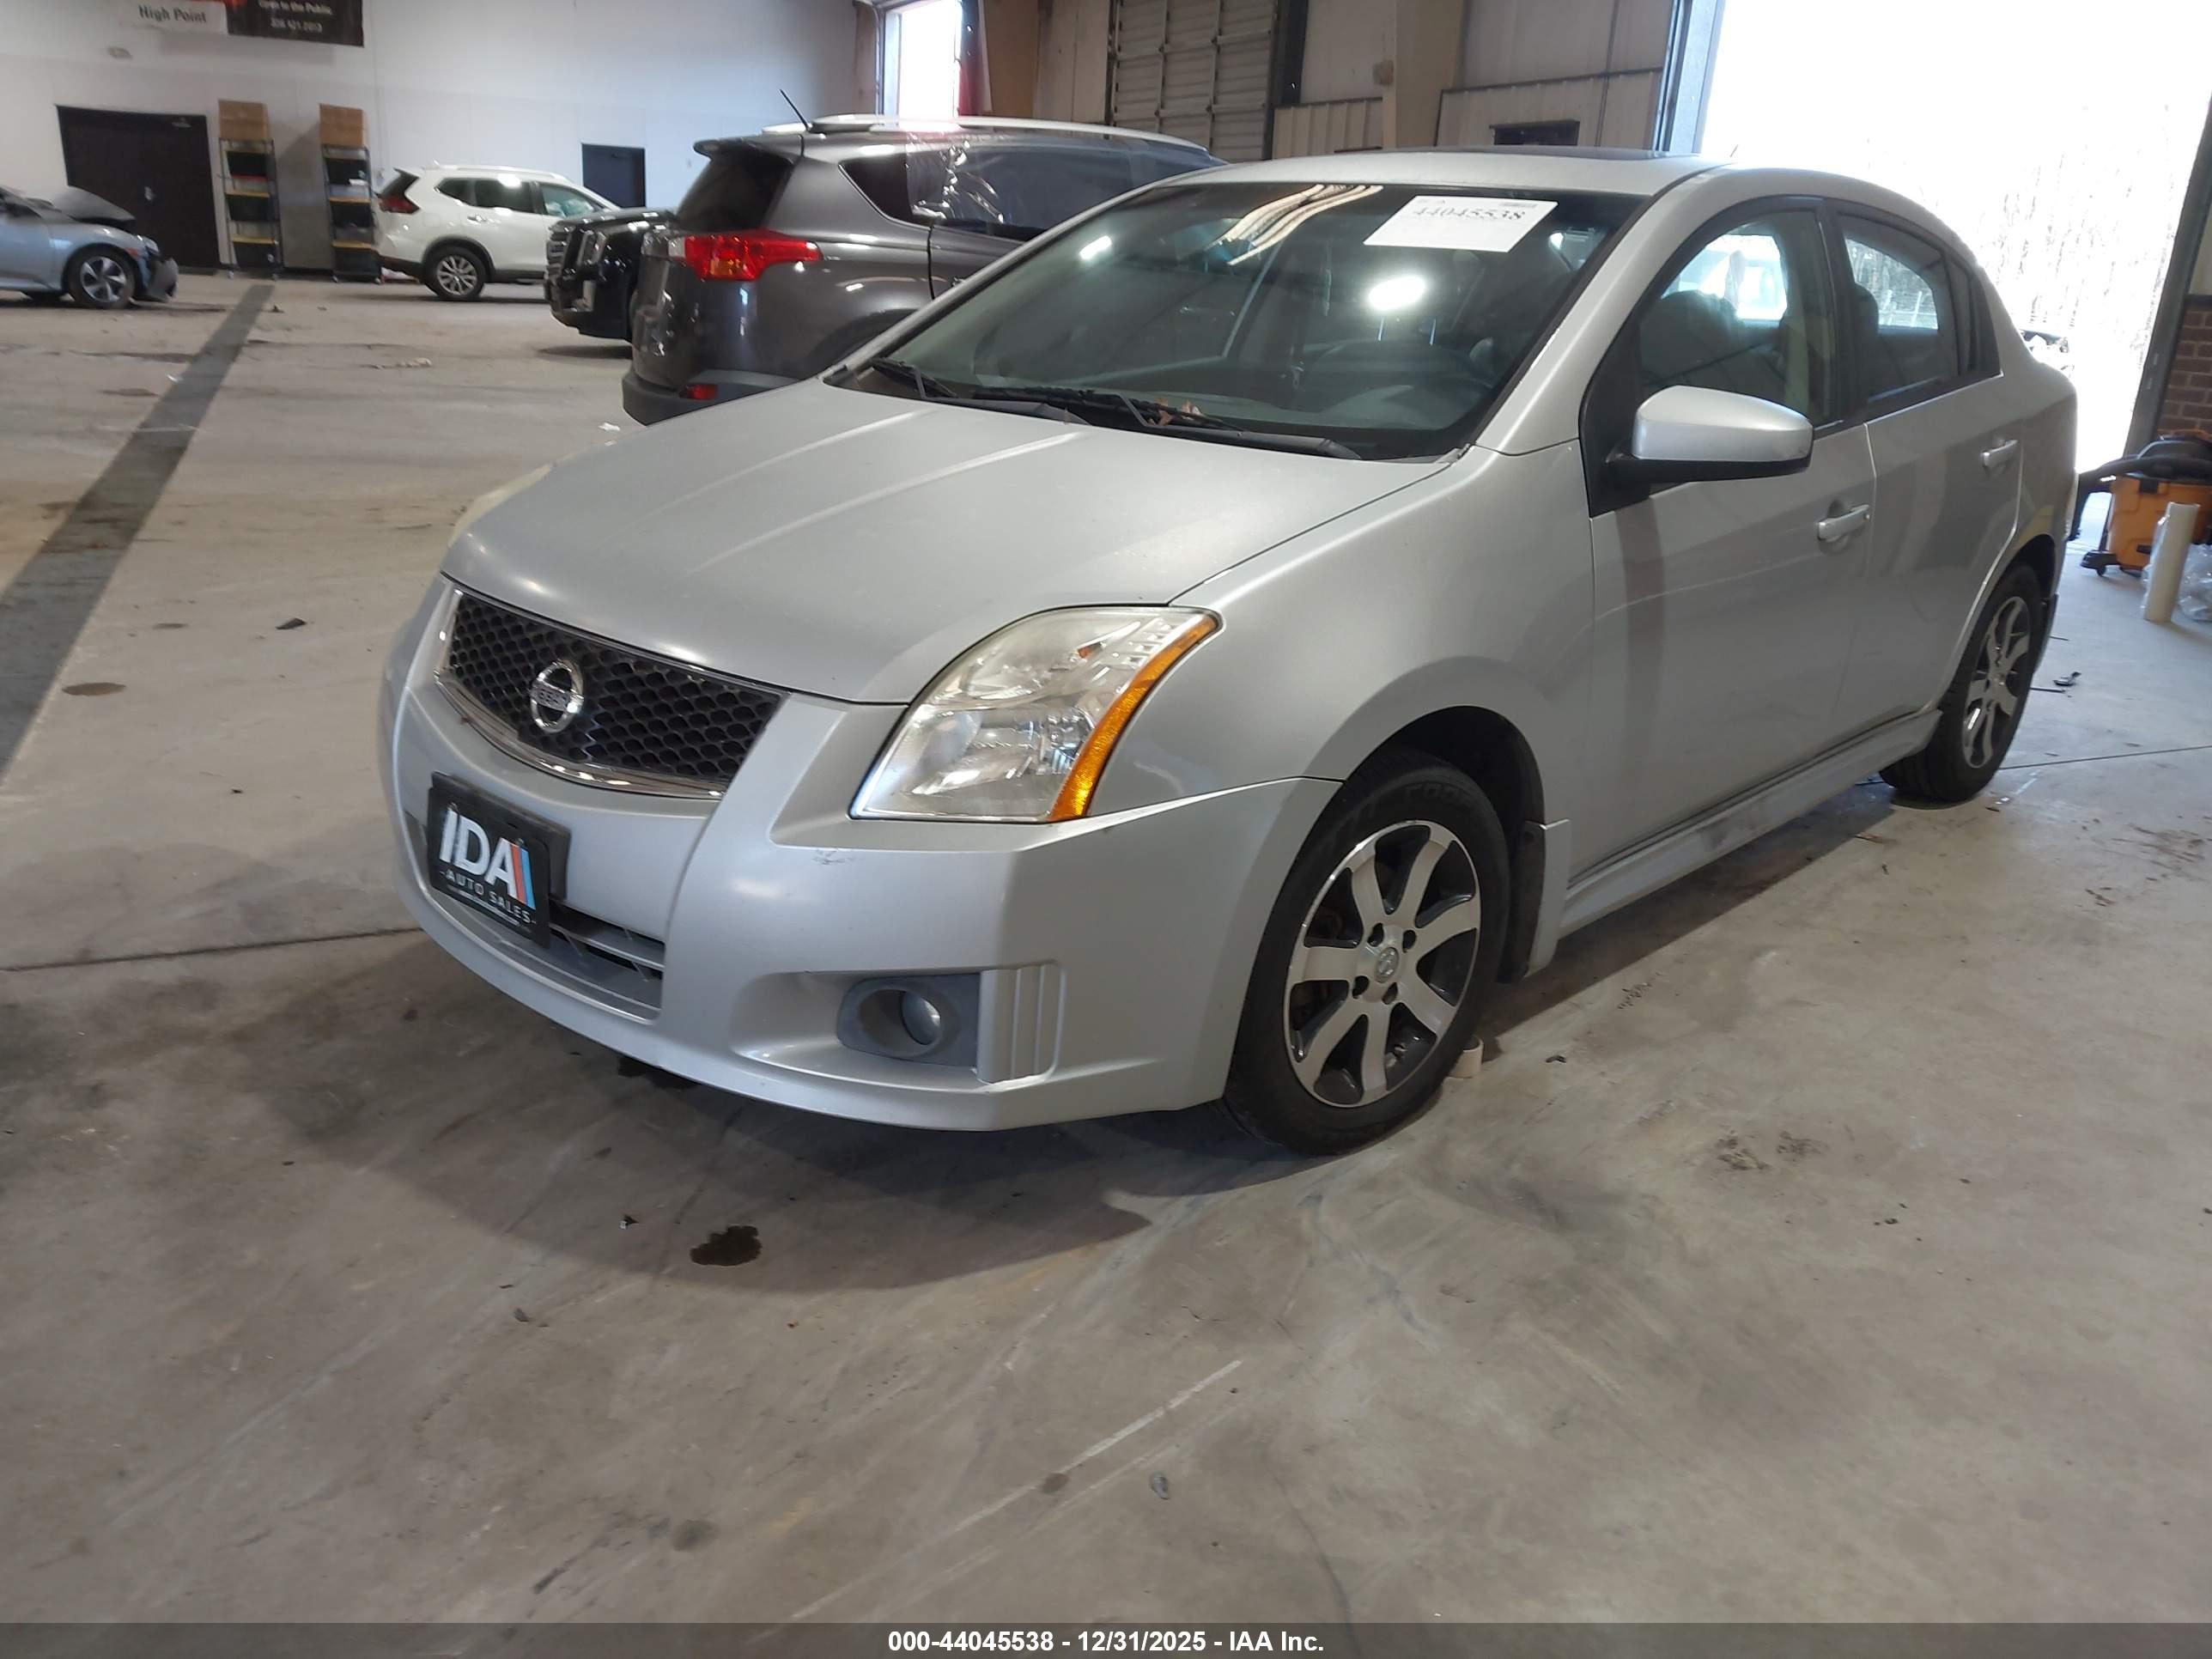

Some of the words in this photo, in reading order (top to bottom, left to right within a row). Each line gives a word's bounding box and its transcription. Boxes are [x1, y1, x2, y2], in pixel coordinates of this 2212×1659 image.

[137, 4, 171, 21] High
[173, 7, 207, 22] Point
[439, 810, 519, 901] IDA
[445, 869, 484, 896] AUTO
[489, 890, 532, 924] SALES
